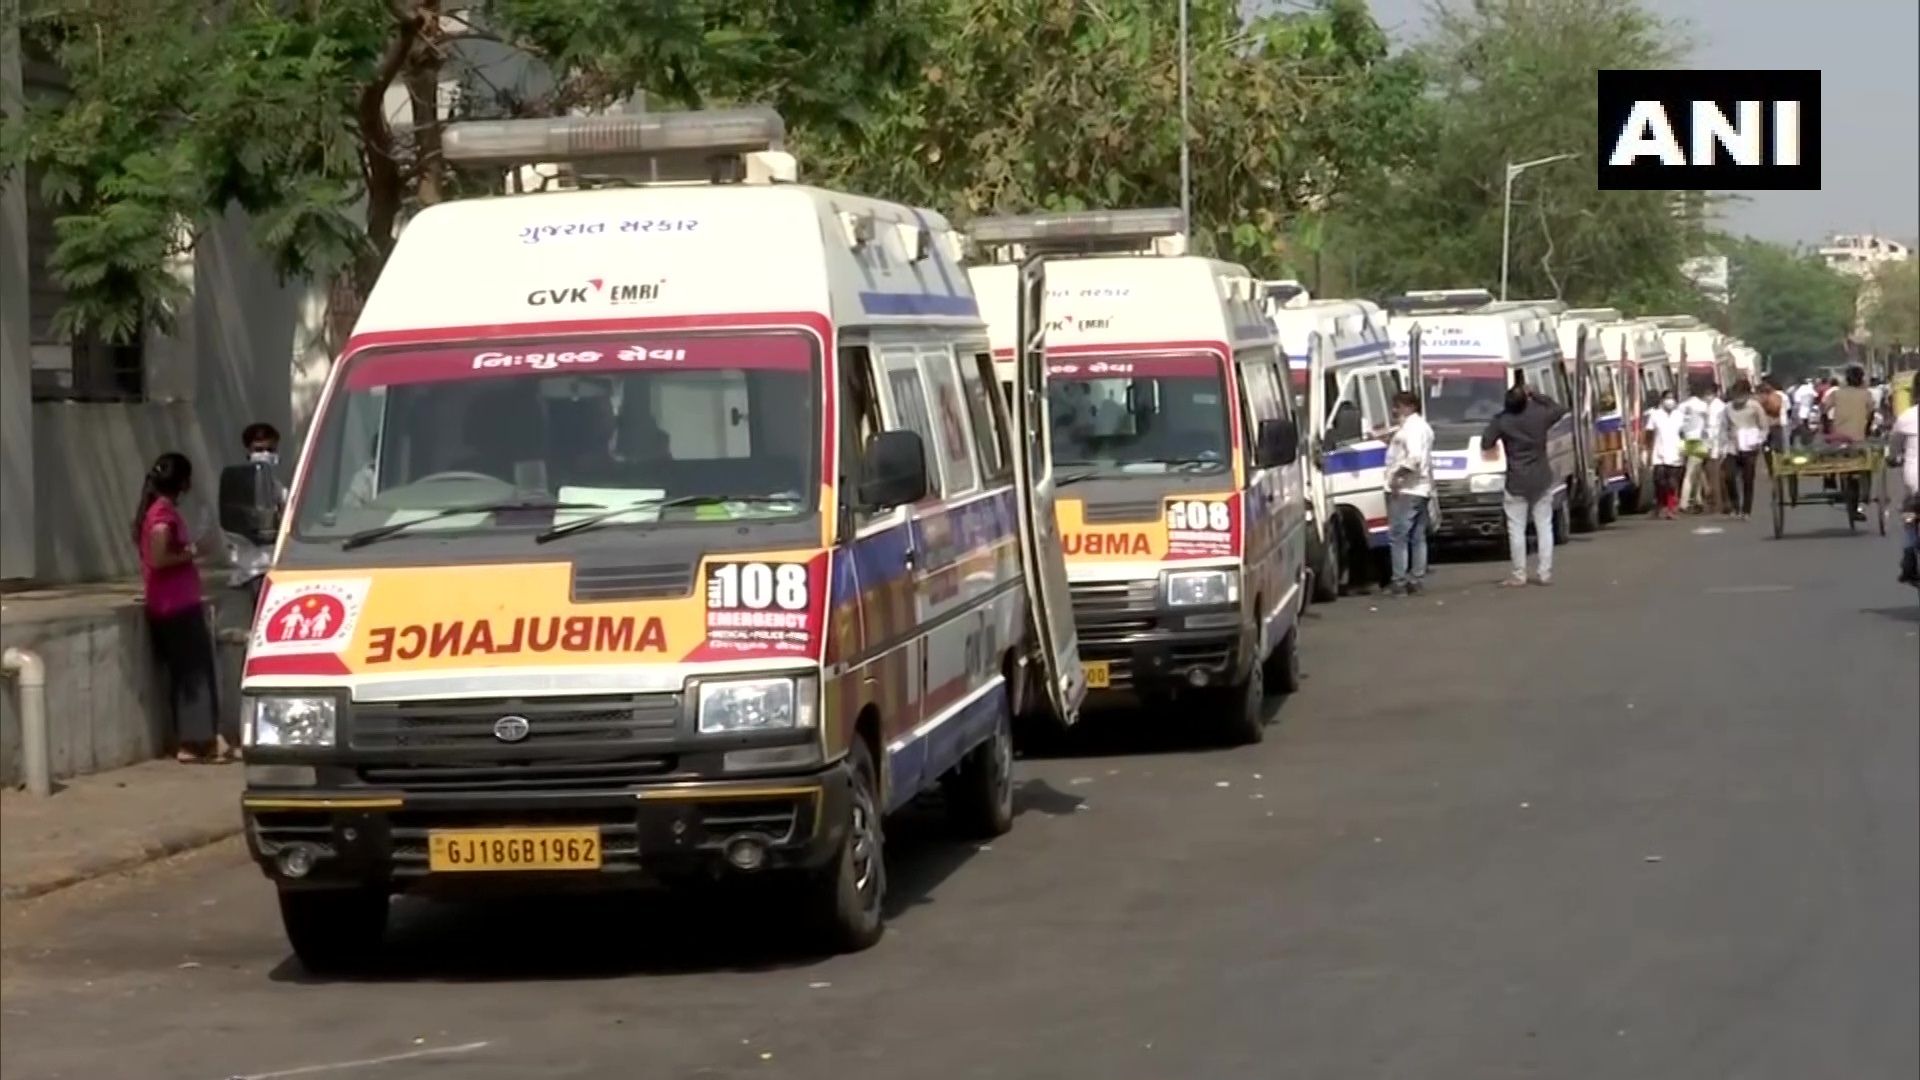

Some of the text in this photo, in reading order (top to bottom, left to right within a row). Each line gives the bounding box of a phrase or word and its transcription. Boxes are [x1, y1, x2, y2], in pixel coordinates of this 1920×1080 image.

[519, 220, 698, 244] ગુજરાત સરકાર
[527, 284, 659, 306] GVK EMRI
[617, 345, 686, 361] સેવા
[1171, 501, 1230, 530] 108
[714, 562, 808, 610] 108
[707, 611, 809, 629] EMERGENCY
[448, 838, 595, 863] GJ18GB1962
